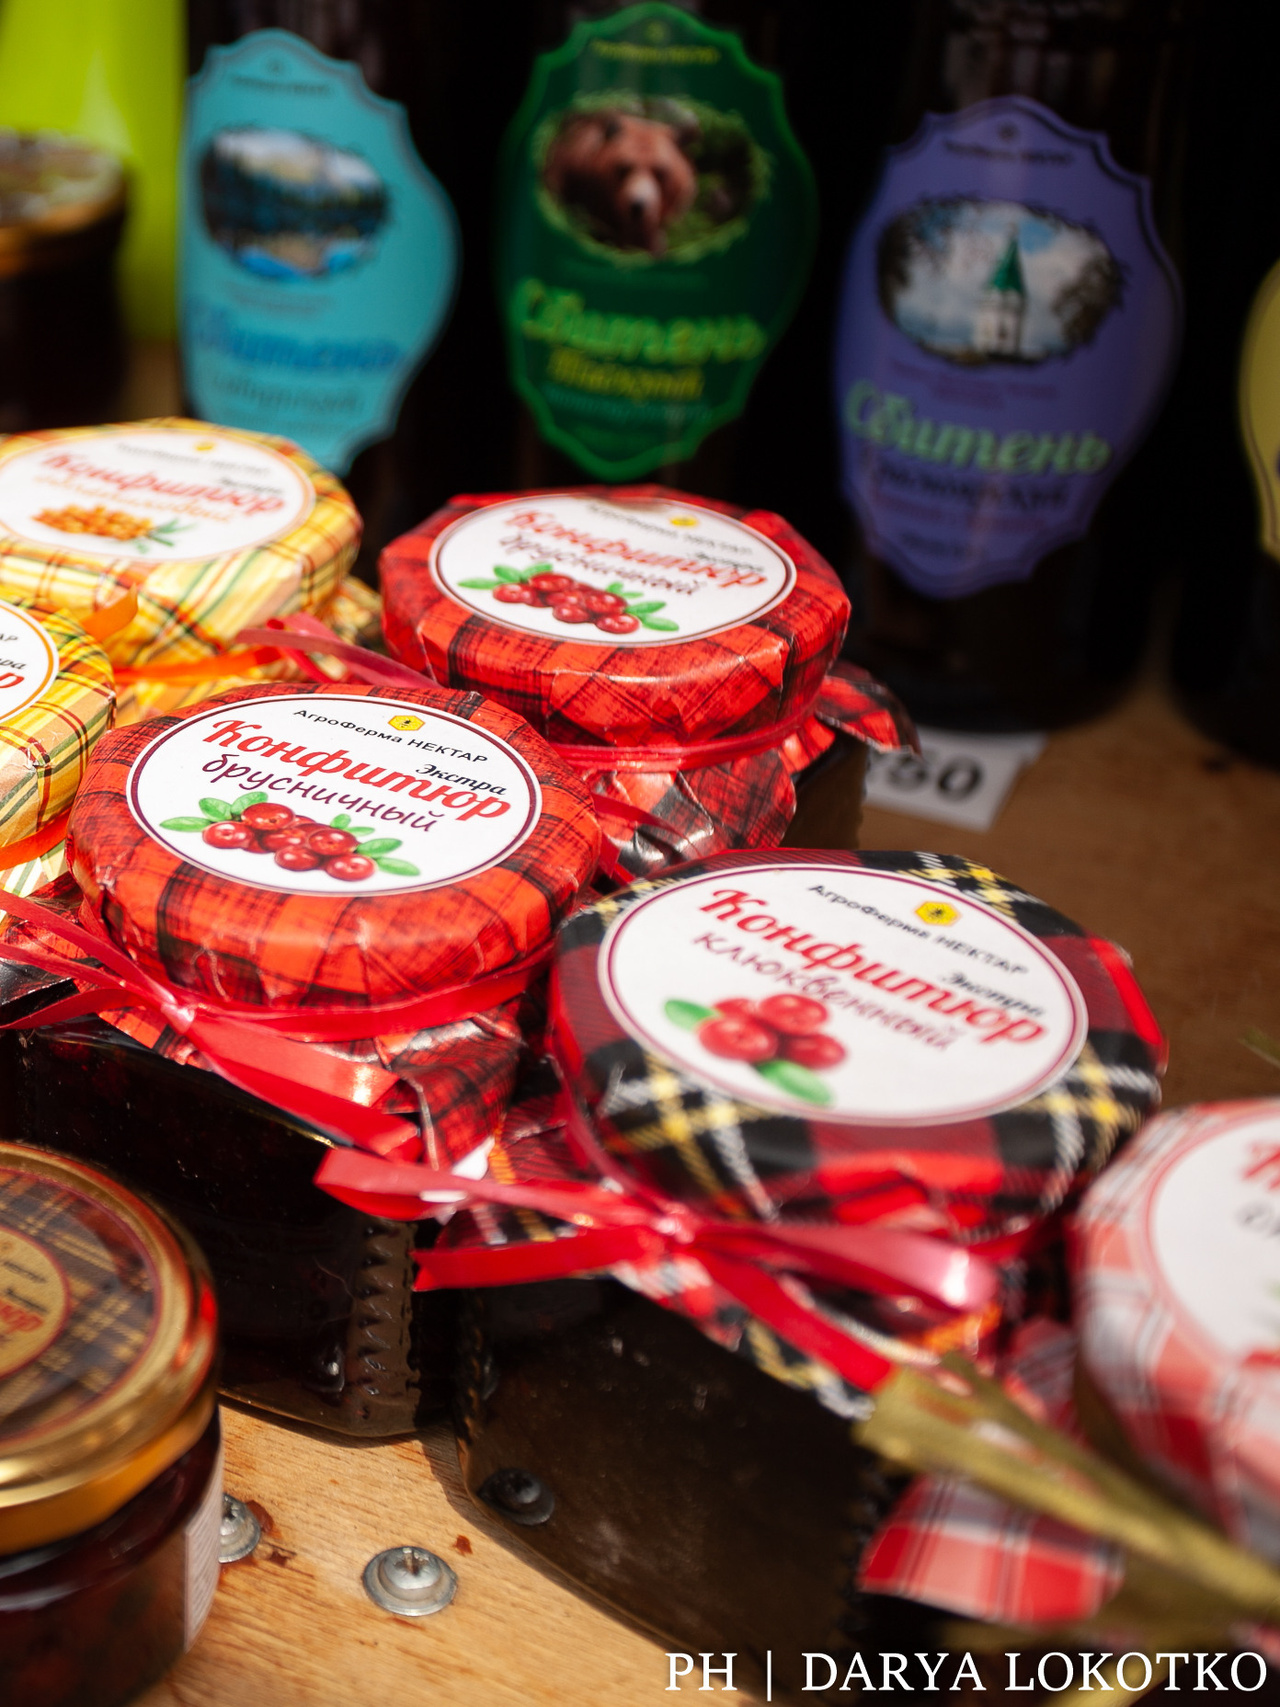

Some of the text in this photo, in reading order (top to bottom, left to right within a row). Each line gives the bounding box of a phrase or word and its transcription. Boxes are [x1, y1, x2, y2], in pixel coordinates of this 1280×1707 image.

[519, 277, 767, 365] Сбитень
[844, 378, 1112, 475] Сбитень
[41, 453, 284, 517] Конфитюр
[500, 534, 708, 596] брусничный
[505, 508, 768, 588] Конфитюр
[202, 719, 512, 822] Конфитюр
[293, 708, 488, 764] АгроФерма НЕКТАР
[202, 753, 445, 833] брусничный
[416, 763, 508, 797] Экстра
[692, 931, 966, 1052] клюквенный
[699, 888, 1047, 1046] Конфитюр
[933, 934, 1030, 977] НЕКТАР
[939, 970, 1044, 1018] Экстра
